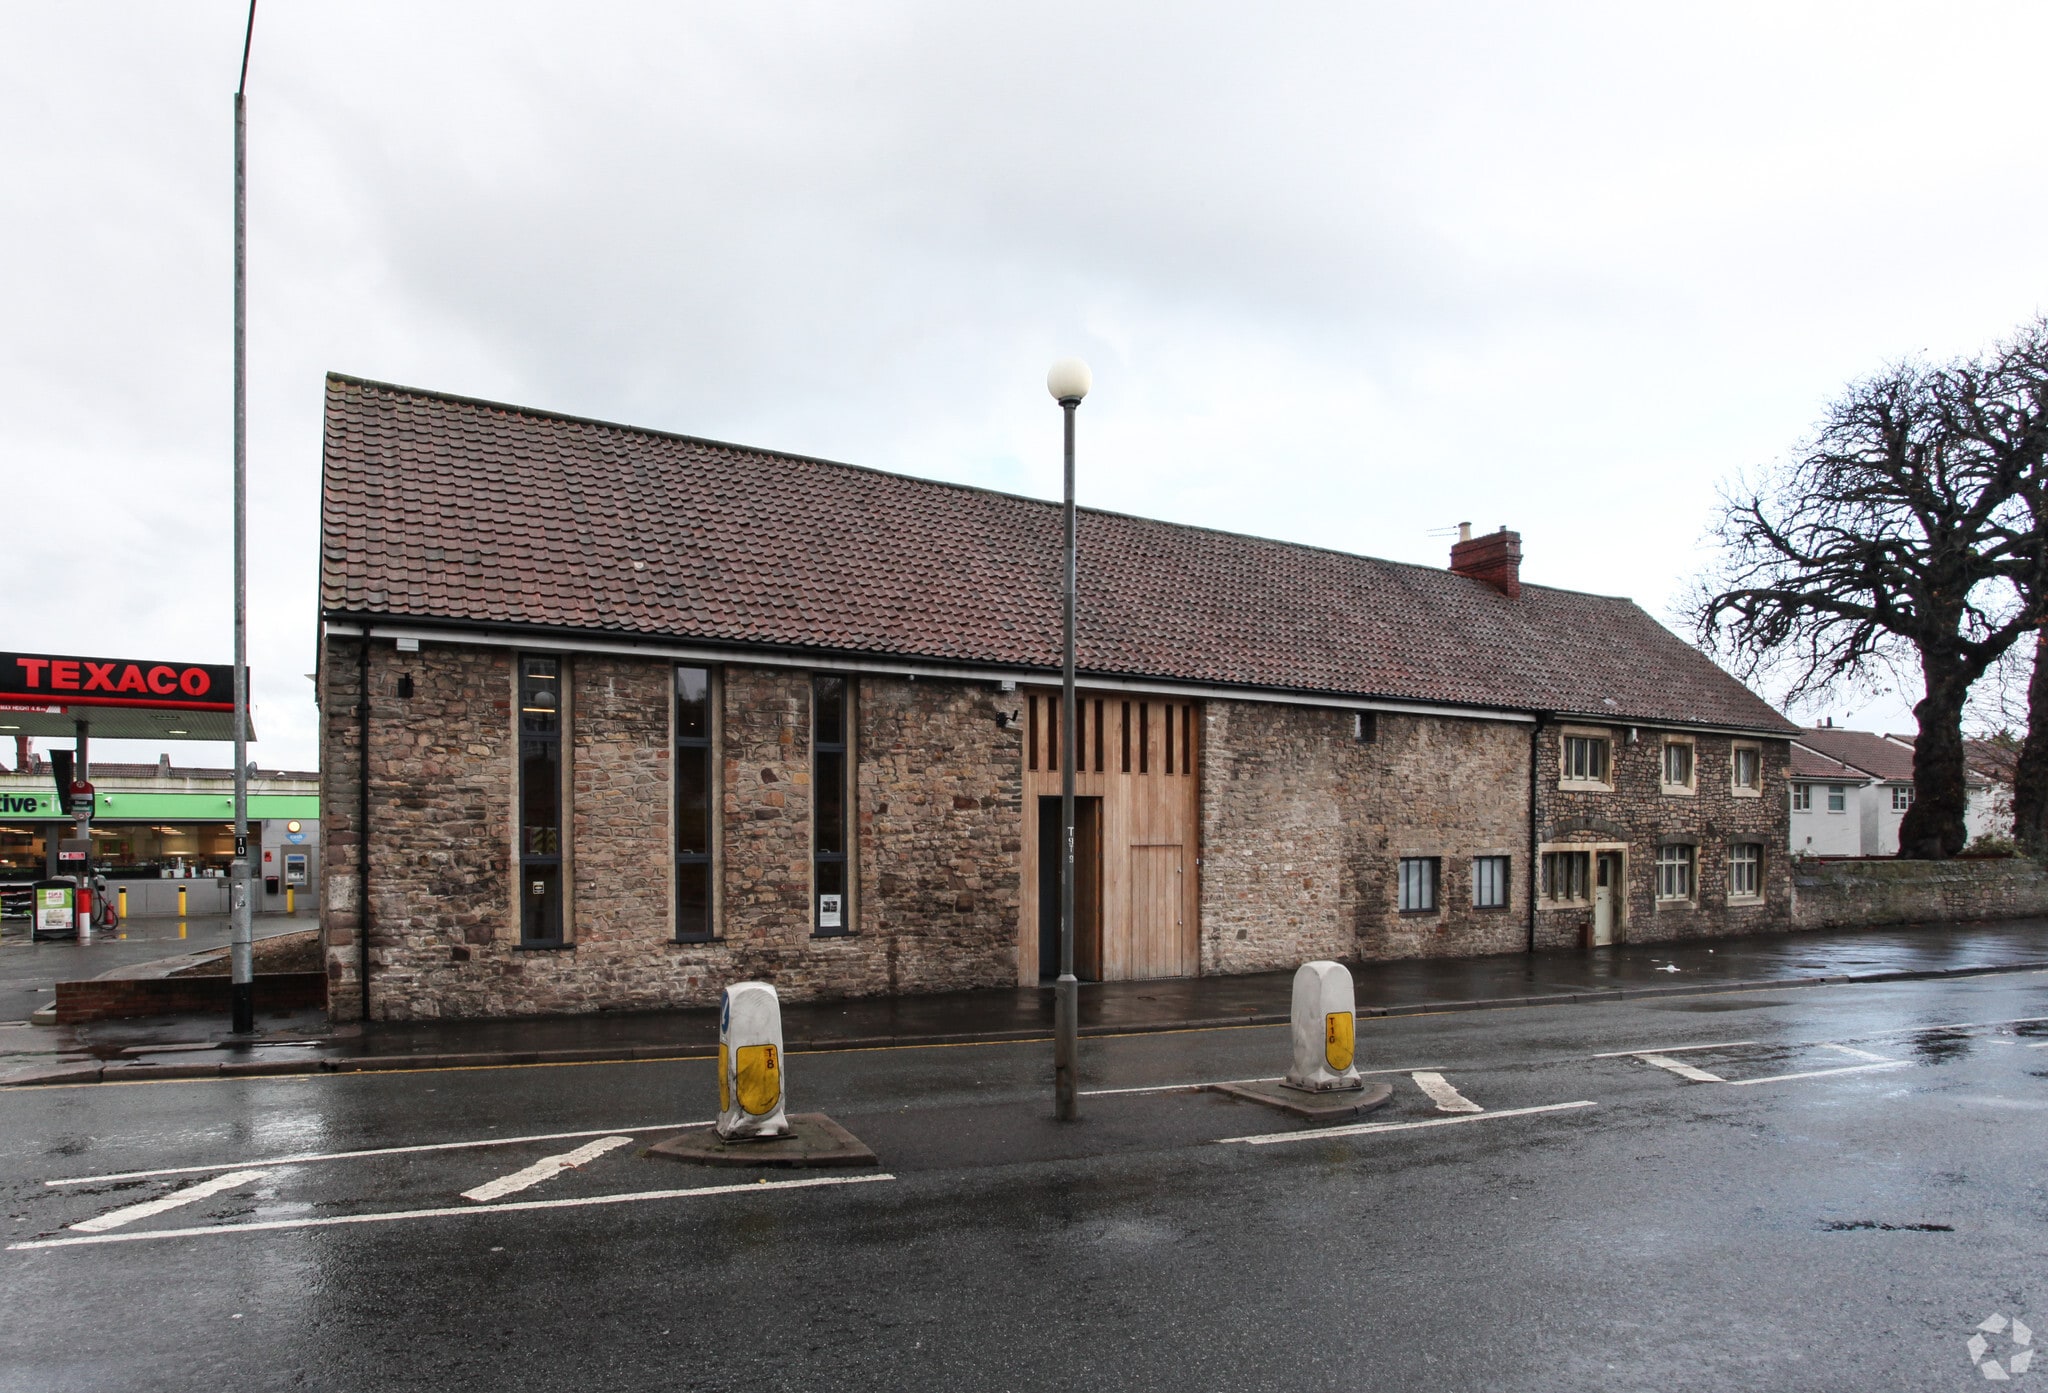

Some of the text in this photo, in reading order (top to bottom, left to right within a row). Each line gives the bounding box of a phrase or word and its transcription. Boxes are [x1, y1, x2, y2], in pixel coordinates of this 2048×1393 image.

[16, 657, 211, 696] TEXACO
[237, 837, 245, 855] 10
[766, 1048, 774, 1069] T8
